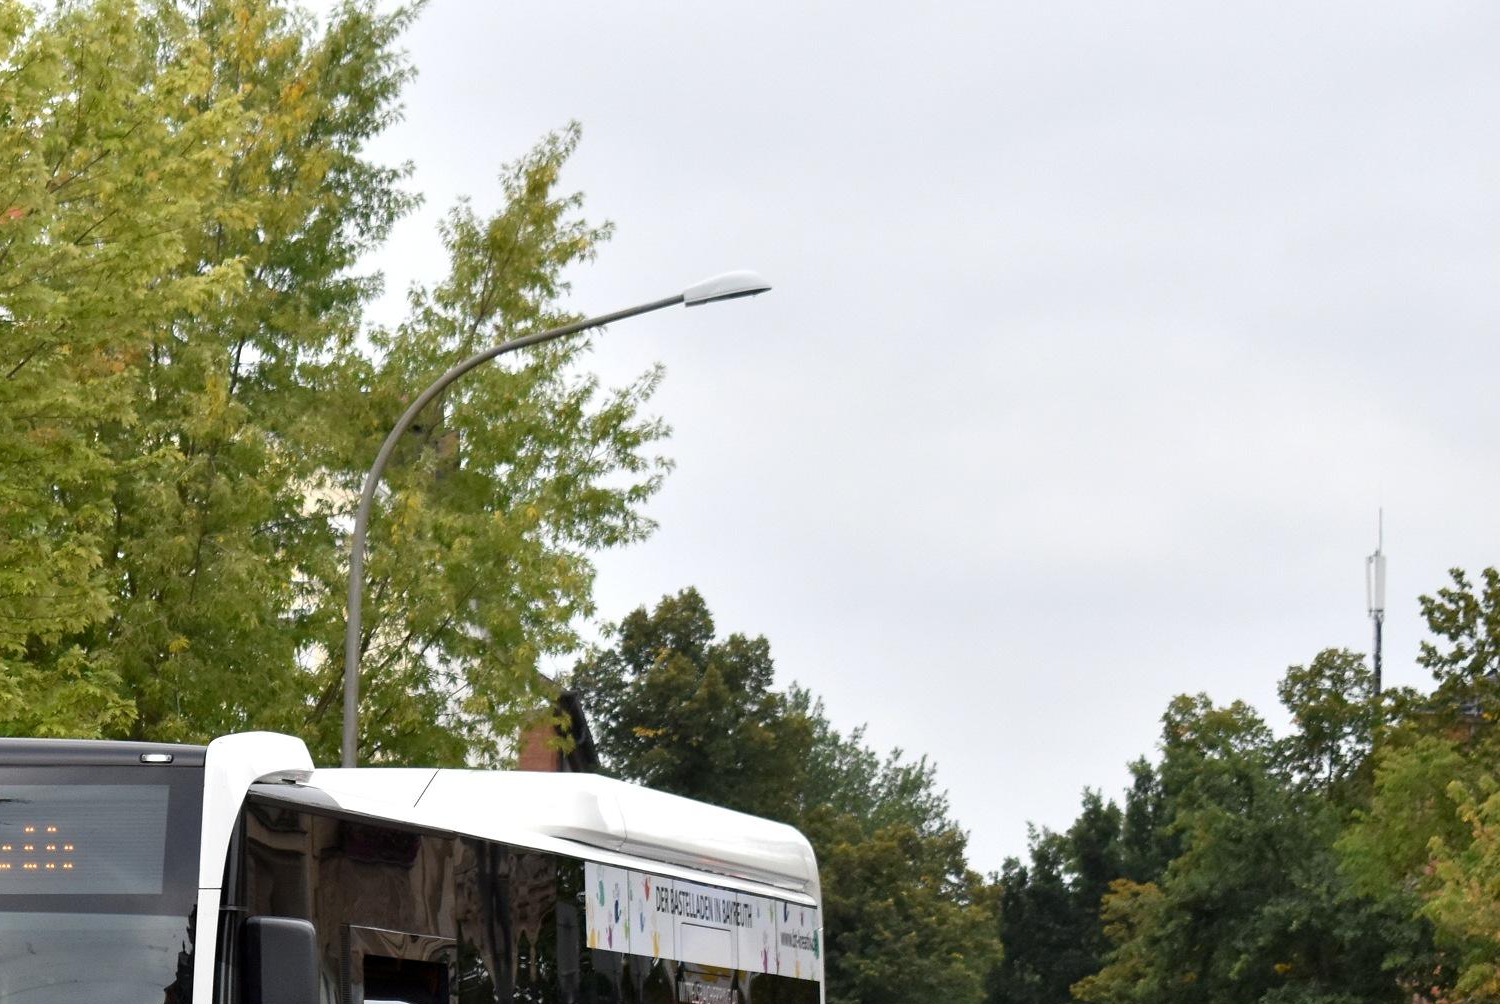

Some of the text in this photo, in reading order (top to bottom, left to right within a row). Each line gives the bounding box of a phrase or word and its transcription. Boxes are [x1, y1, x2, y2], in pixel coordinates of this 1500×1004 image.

[656, 886, 752, 928] DER BASTELLADEN IN BAYREUTH
